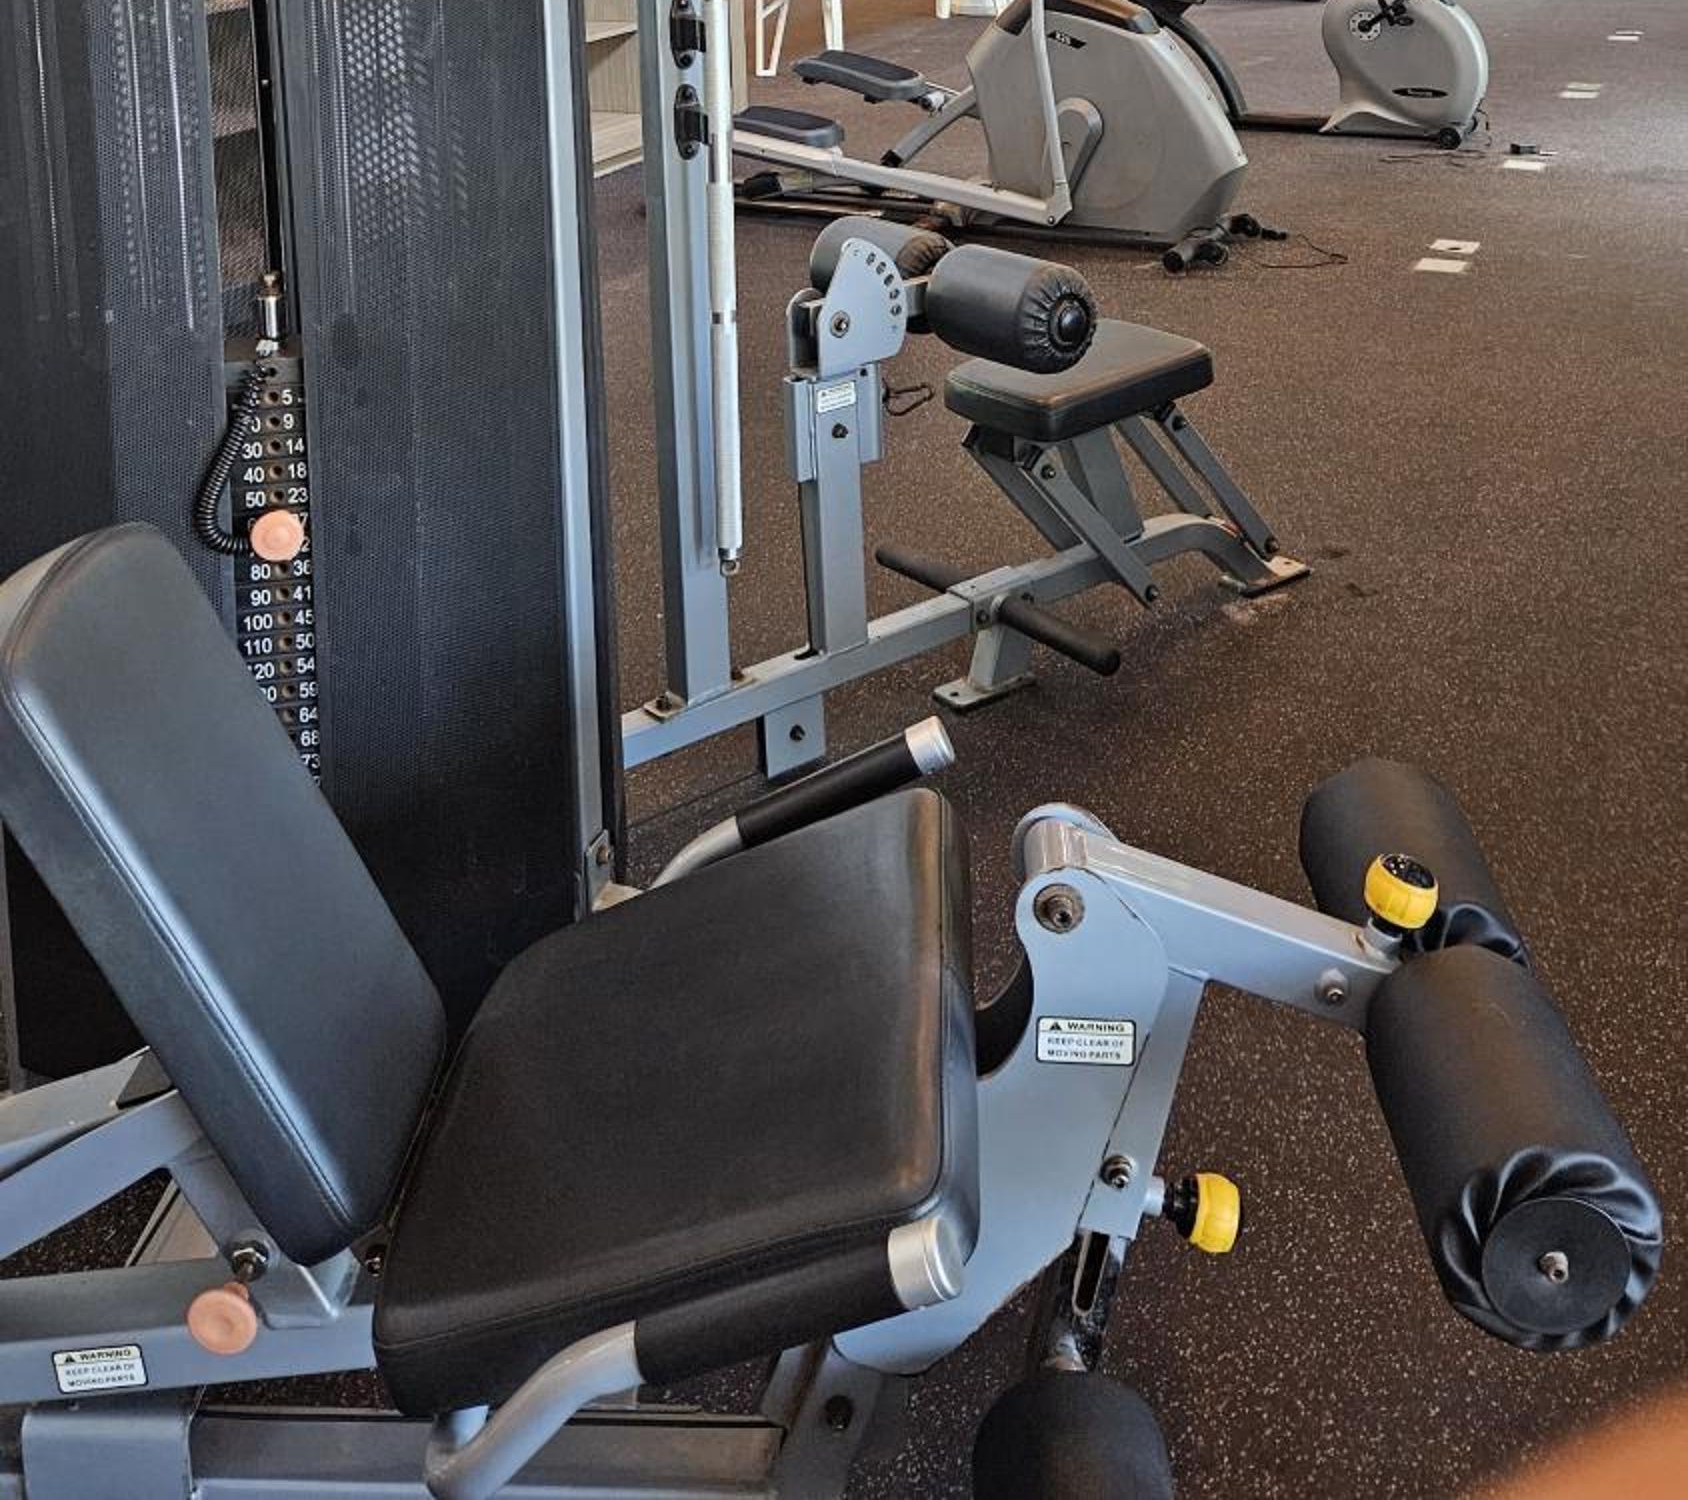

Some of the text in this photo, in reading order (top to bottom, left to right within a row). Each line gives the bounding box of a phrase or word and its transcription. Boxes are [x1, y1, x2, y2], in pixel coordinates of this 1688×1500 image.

[283, 413, 294, 430] 9
[242, 437, 305, 459] 30 14
[243, 462, 307, 483] 40 18
[245, 486, 309, 508] 50 23
[251, 563, 271, 580] 80
[251, 586, 312, 606] 90 41
[243, 609, 313, 631] 100 45
[244, 634, 314, 655] 110 50
[247, 656, 315, 680] 20 54
[299, 706, 318, 723] 64
[300, 730, 320, 747] 68
[1067, 1021, 1125, 1033] WARNING
[1047, 1037, 1124, 1048] KEEP CLEAR OF
[1047, 1049, 1121, 1060] MOVING PARTS
[79, 1348, 132, 1361] WARNING
[65, 1366, 89, 1376] KEEP
[91, 1364, 123, 1374] CLEAR
[67, 1373, 136, 1388] MOVING PARTS
